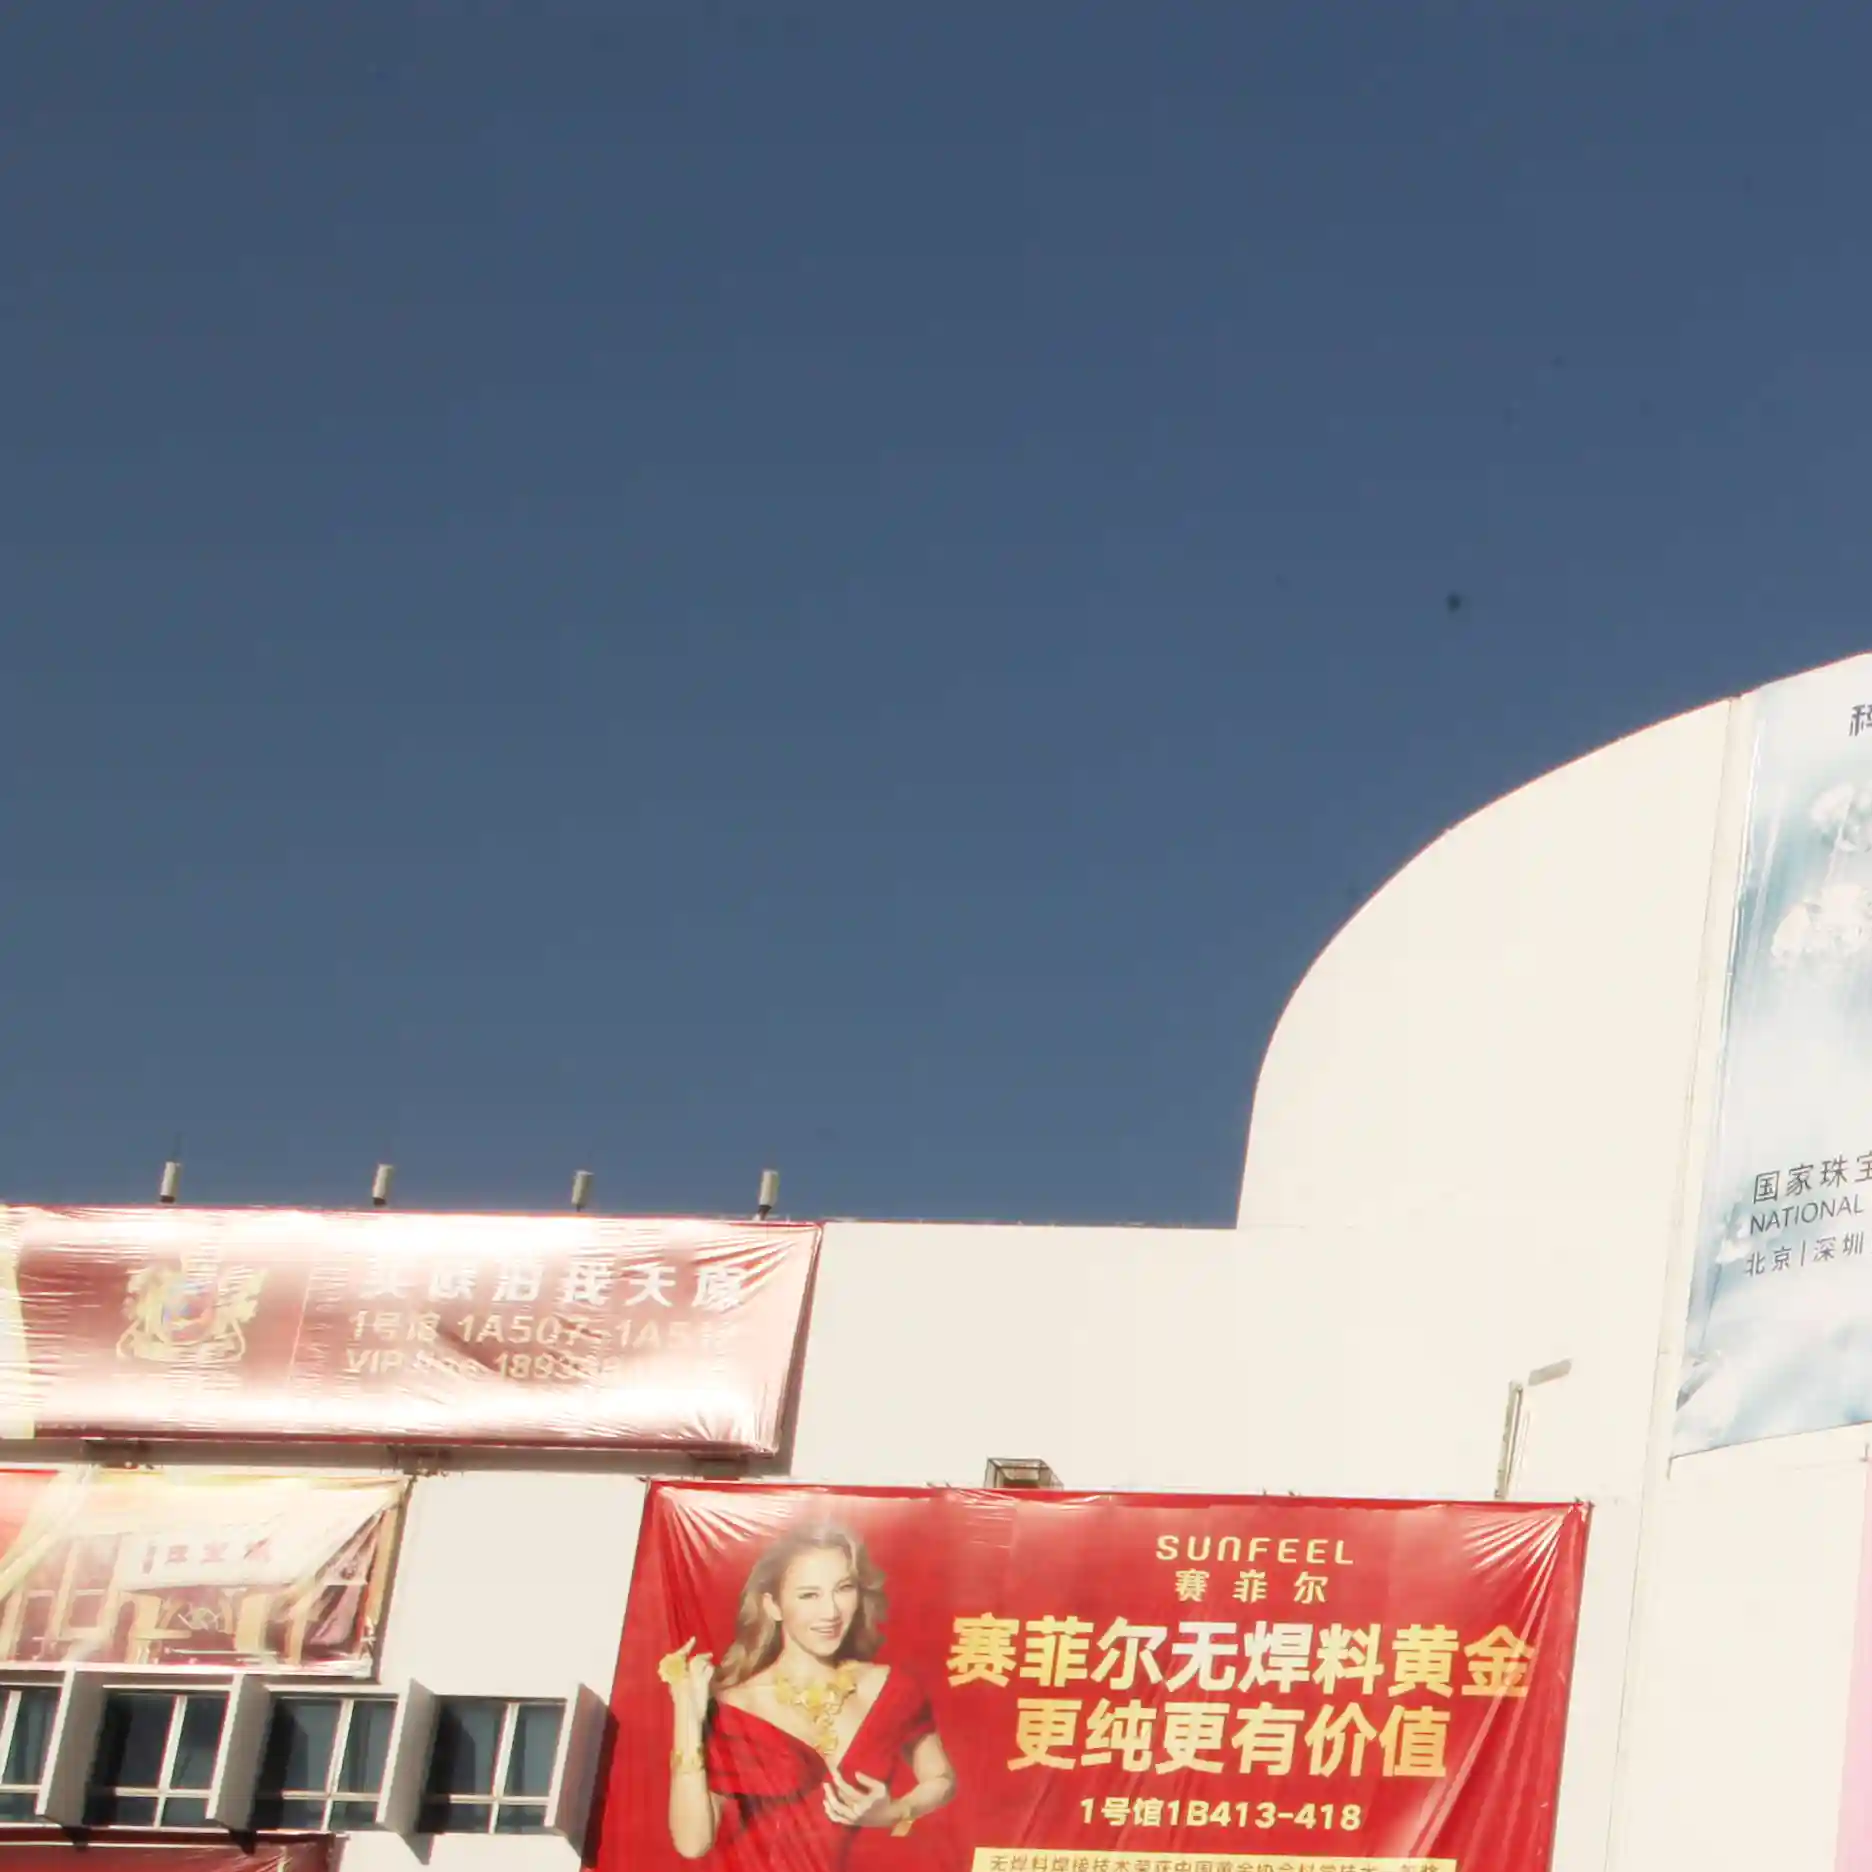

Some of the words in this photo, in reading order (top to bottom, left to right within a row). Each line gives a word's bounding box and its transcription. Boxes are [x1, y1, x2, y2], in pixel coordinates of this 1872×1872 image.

[1750, 1192, 1864, 1237] NATIONAL
[1155, 1534, 1355, 1566] SUNFEEL
[1174, 1569, 1328, 1605] 赛菲尔
[945, 1611, 1535, 1700] 赛菲尔无焊料黄金
[1006, 1697, 1452, 1779] 更纯更有价值
[1079, 1795, 1362, 1832] 1号馆1B413-418
